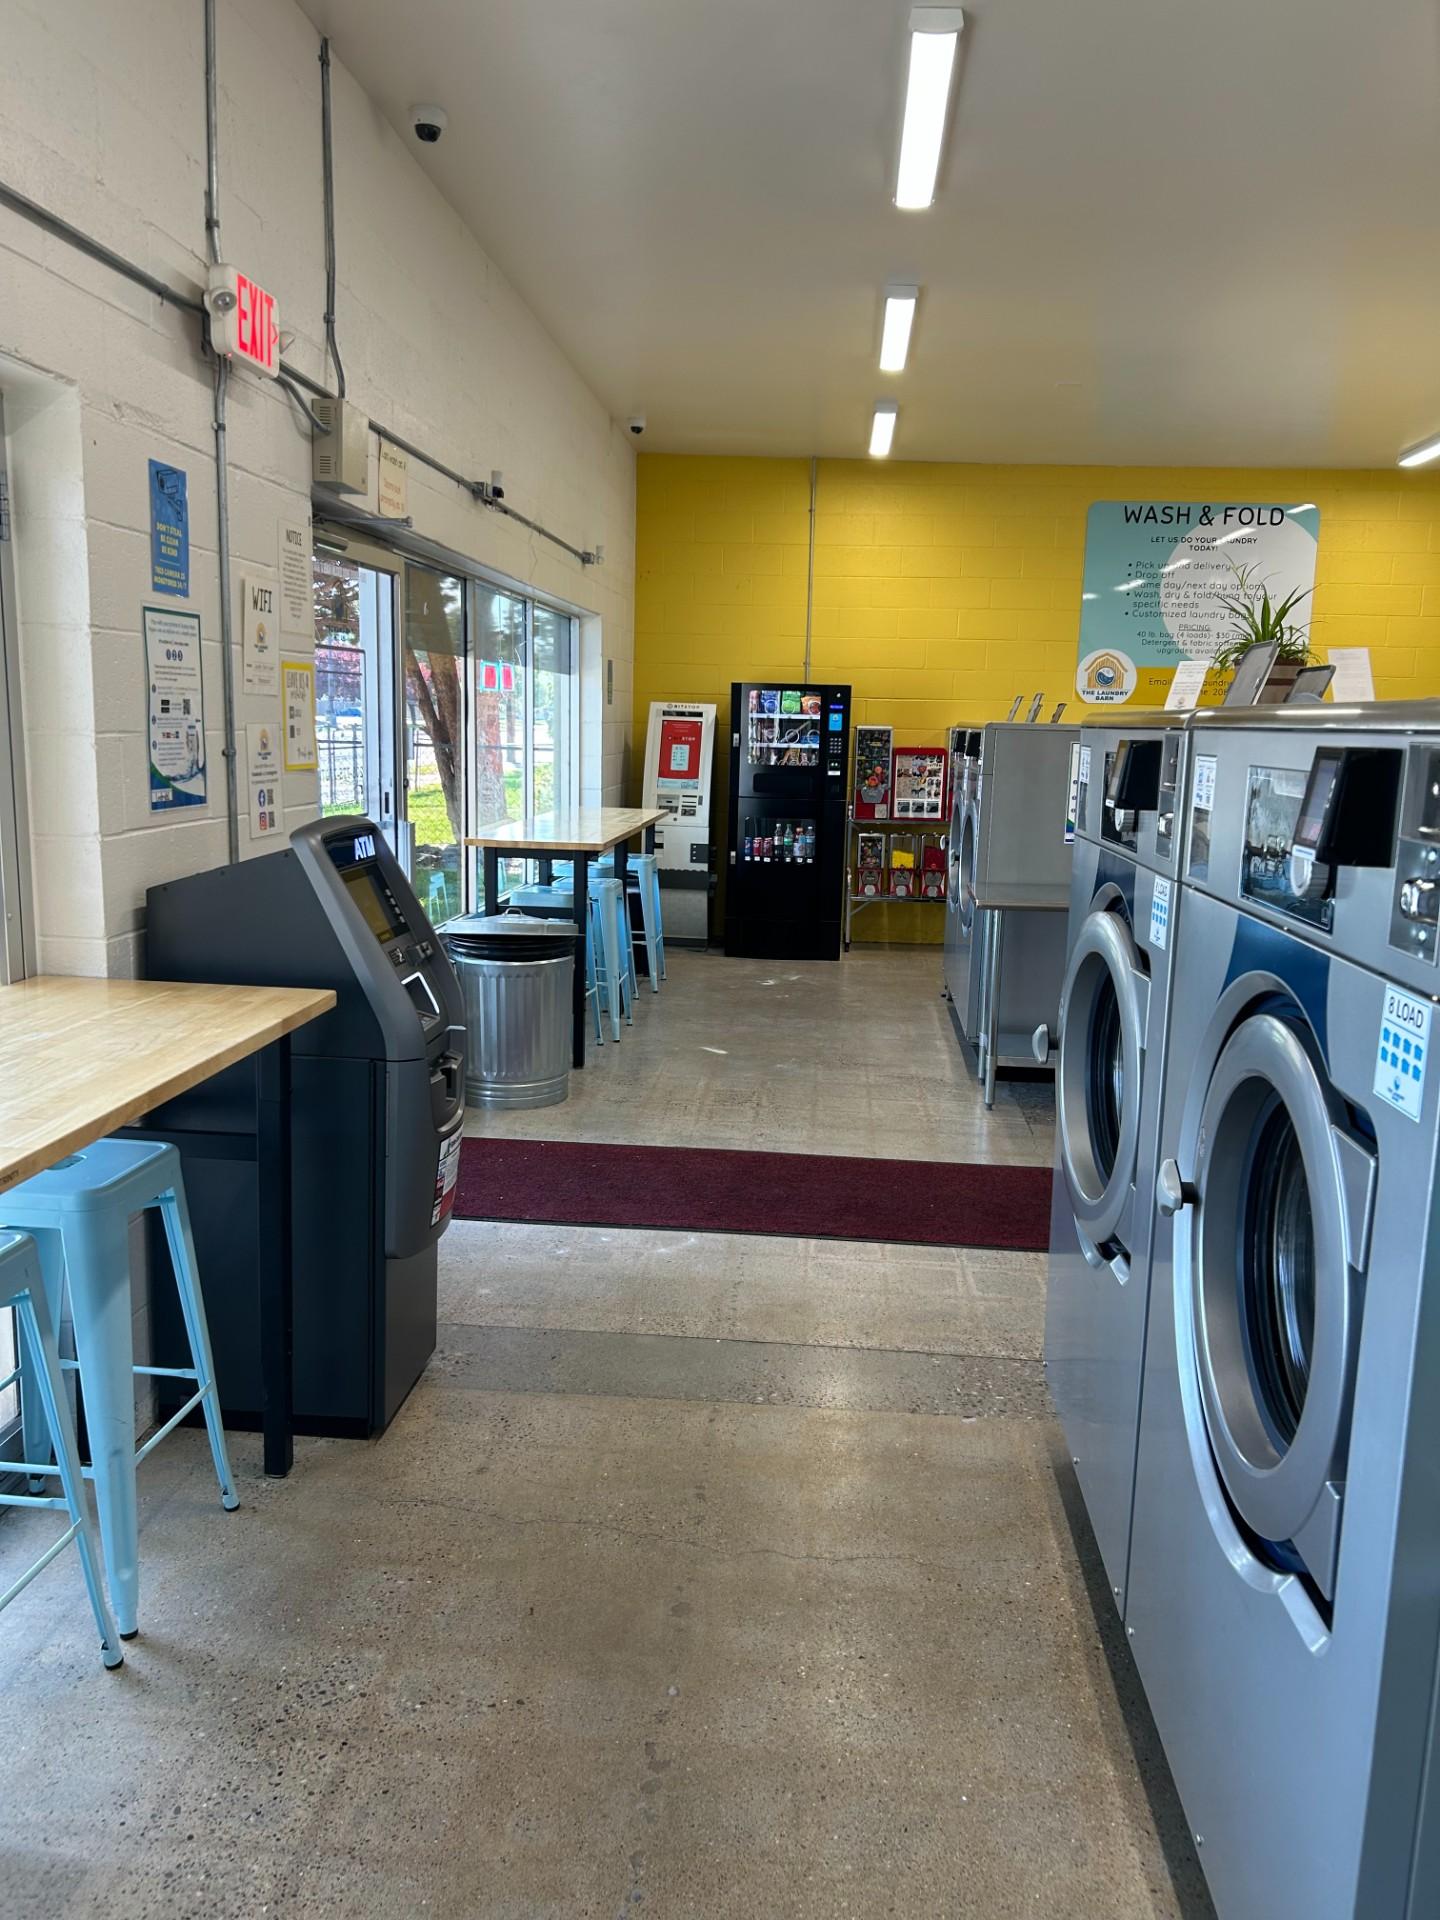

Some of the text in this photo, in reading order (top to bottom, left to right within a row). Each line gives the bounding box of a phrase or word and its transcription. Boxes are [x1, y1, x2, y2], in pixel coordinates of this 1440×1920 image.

[237, 272, 274, 368] EXIT
[1124, 505, 1285, 526] WASH & FOLD
[1195, 536, 1217, 544] YOUR
[1135, 561, 1155, 569] Pick
[1193, 561, 1231, 572] delivery
[1135, 570, 1159, 579] Drop
[1163, 580, 1206, 590] day/next
[1209, 581, 1227, 591] day
[252, 585, 273, 614] WIFI
[1134, 590, 1162, 599] Wash,
[1164, 591, 1180, 600] dry
[1183, 591, 1190, 599] &
[1132, 601, 1169, 609] specific
[1132, 609, 1187, 618] Customized
[1190, 610, 1226, 620] laundry
[1178, 623, 1211, 631] PRICING
[1141, 639, 1180, 647] Detergent
[353, 834, 376, 861] ATM
[1388, 995, 1424, 1029] 8 LOAD
